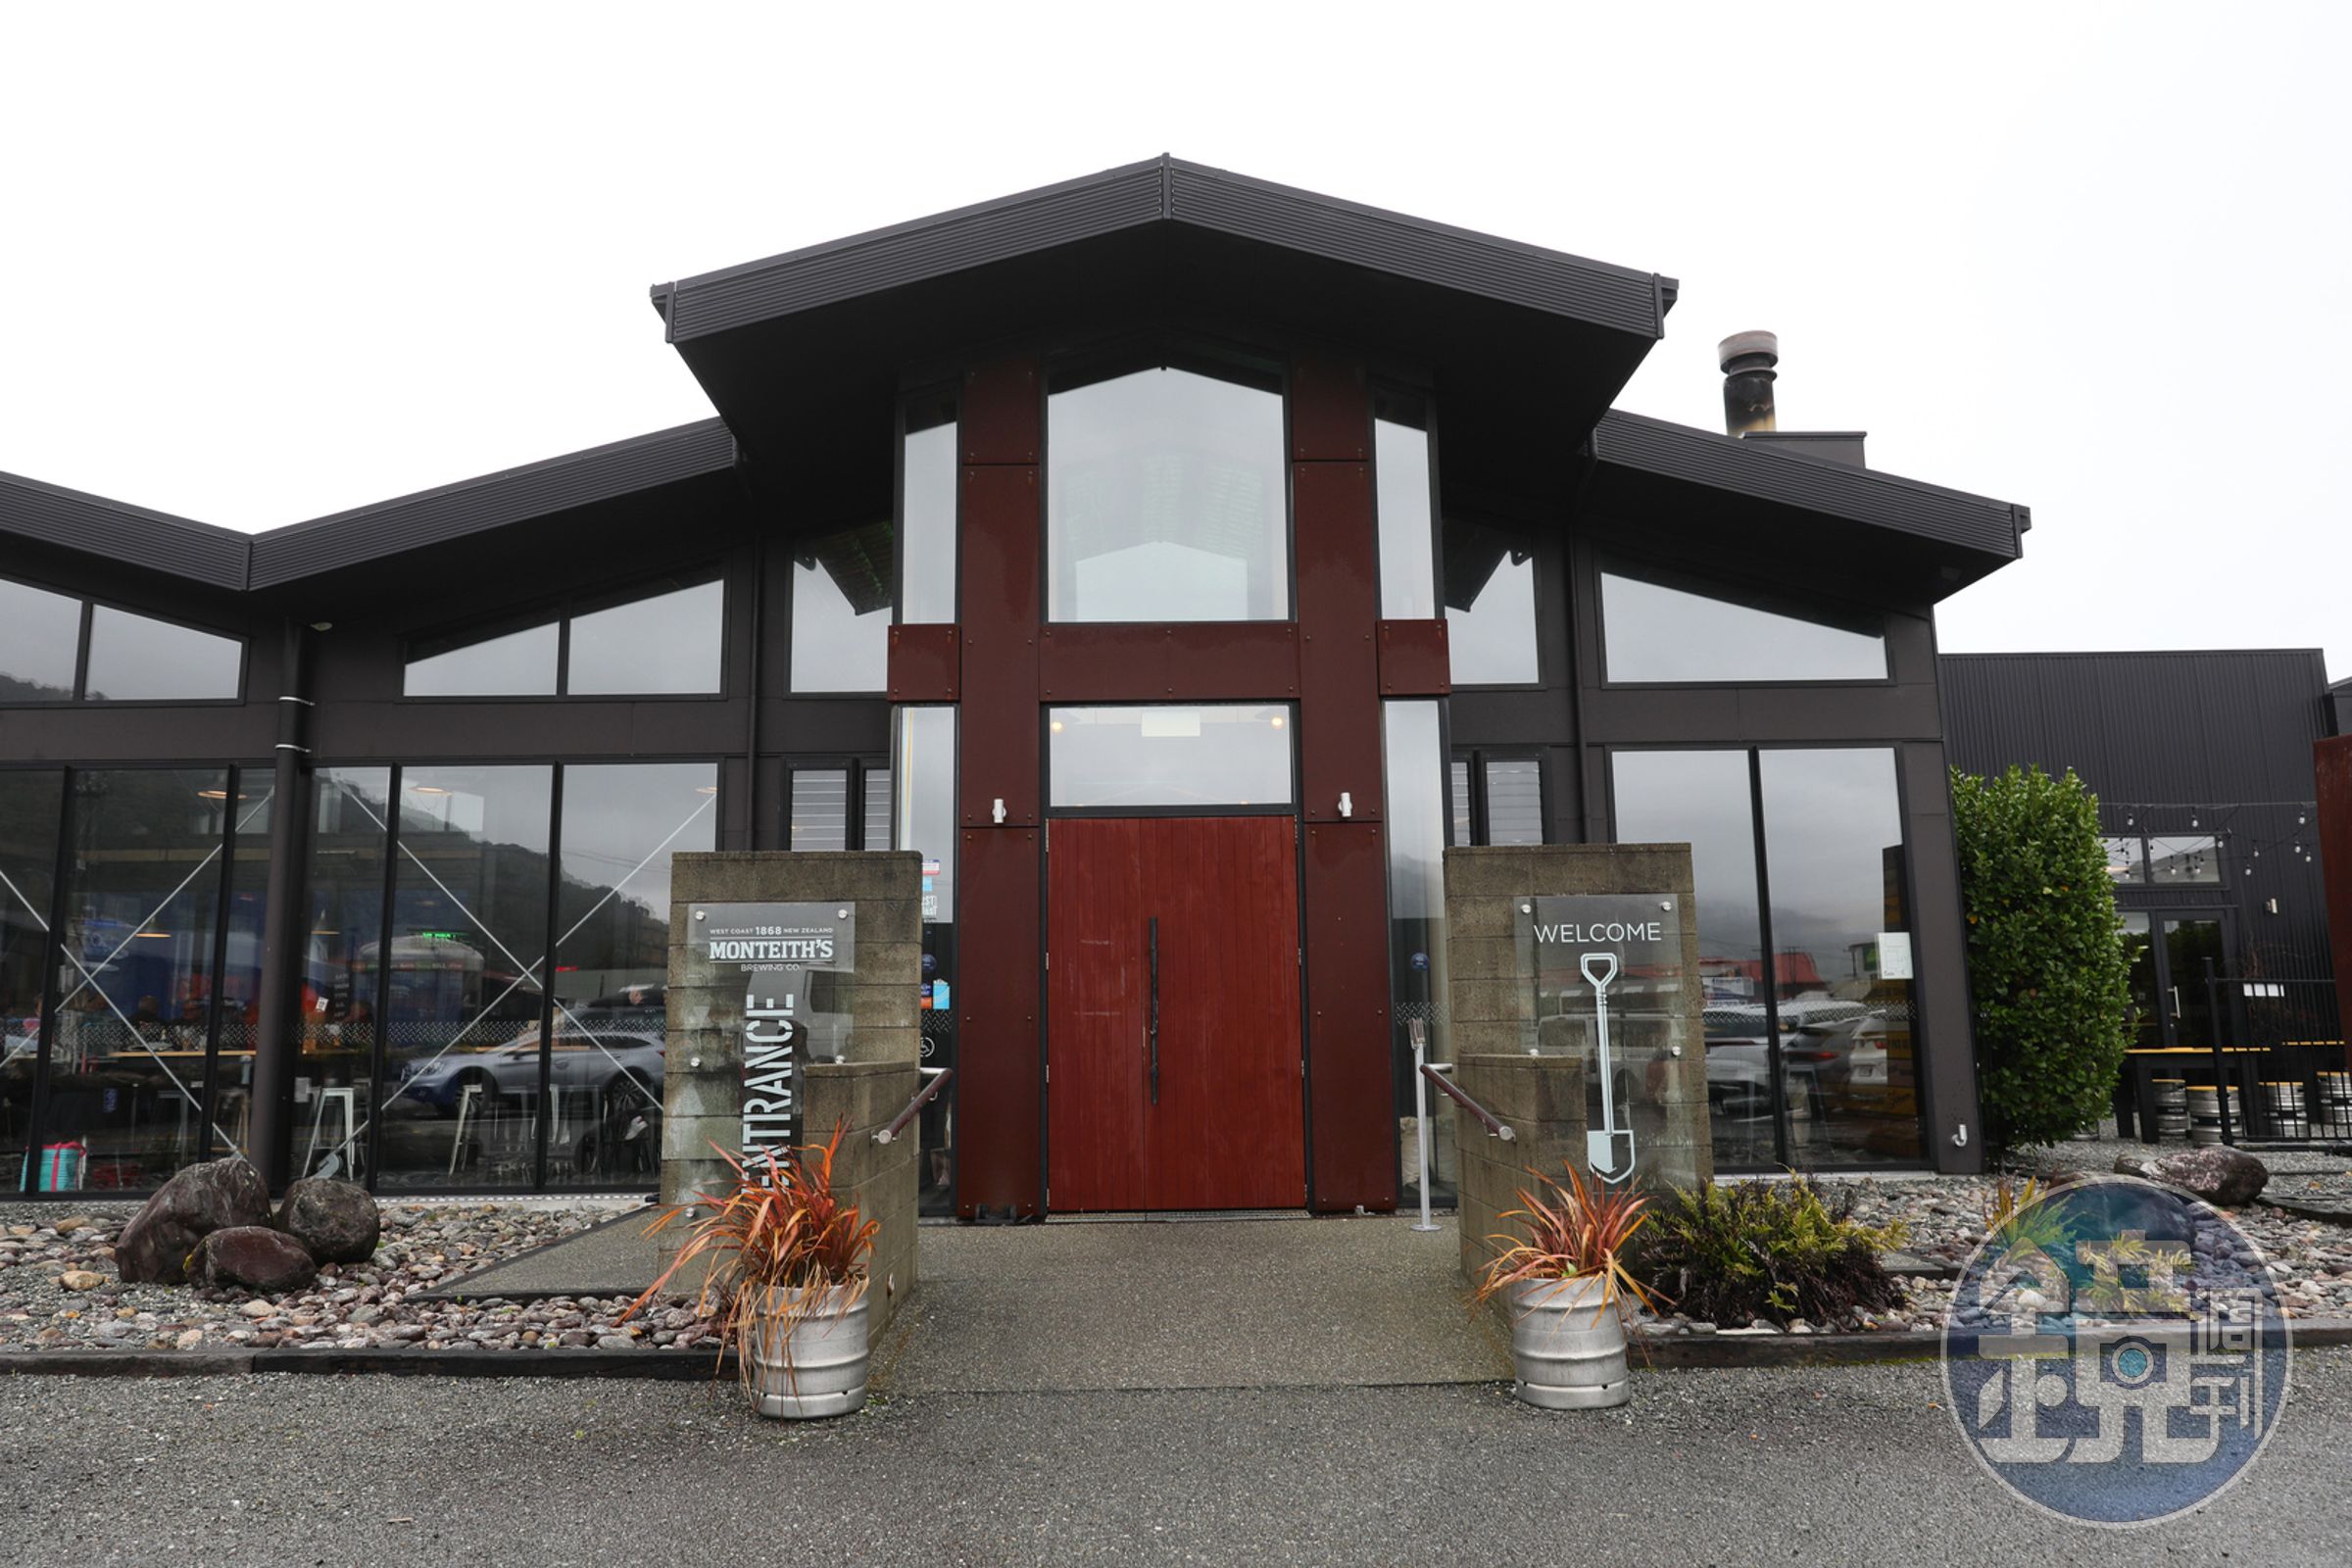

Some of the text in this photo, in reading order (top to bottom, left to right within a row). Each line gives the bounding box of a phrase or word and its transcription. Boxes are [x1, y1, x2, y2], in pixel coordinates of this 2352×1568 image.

[755, 926, 782, 936] 1868
[1534, 922, 1662, 944] WELCOME
[709, 939, 833, 959] MONTEITH'S
[740, 963, 784, 972] BREWING
